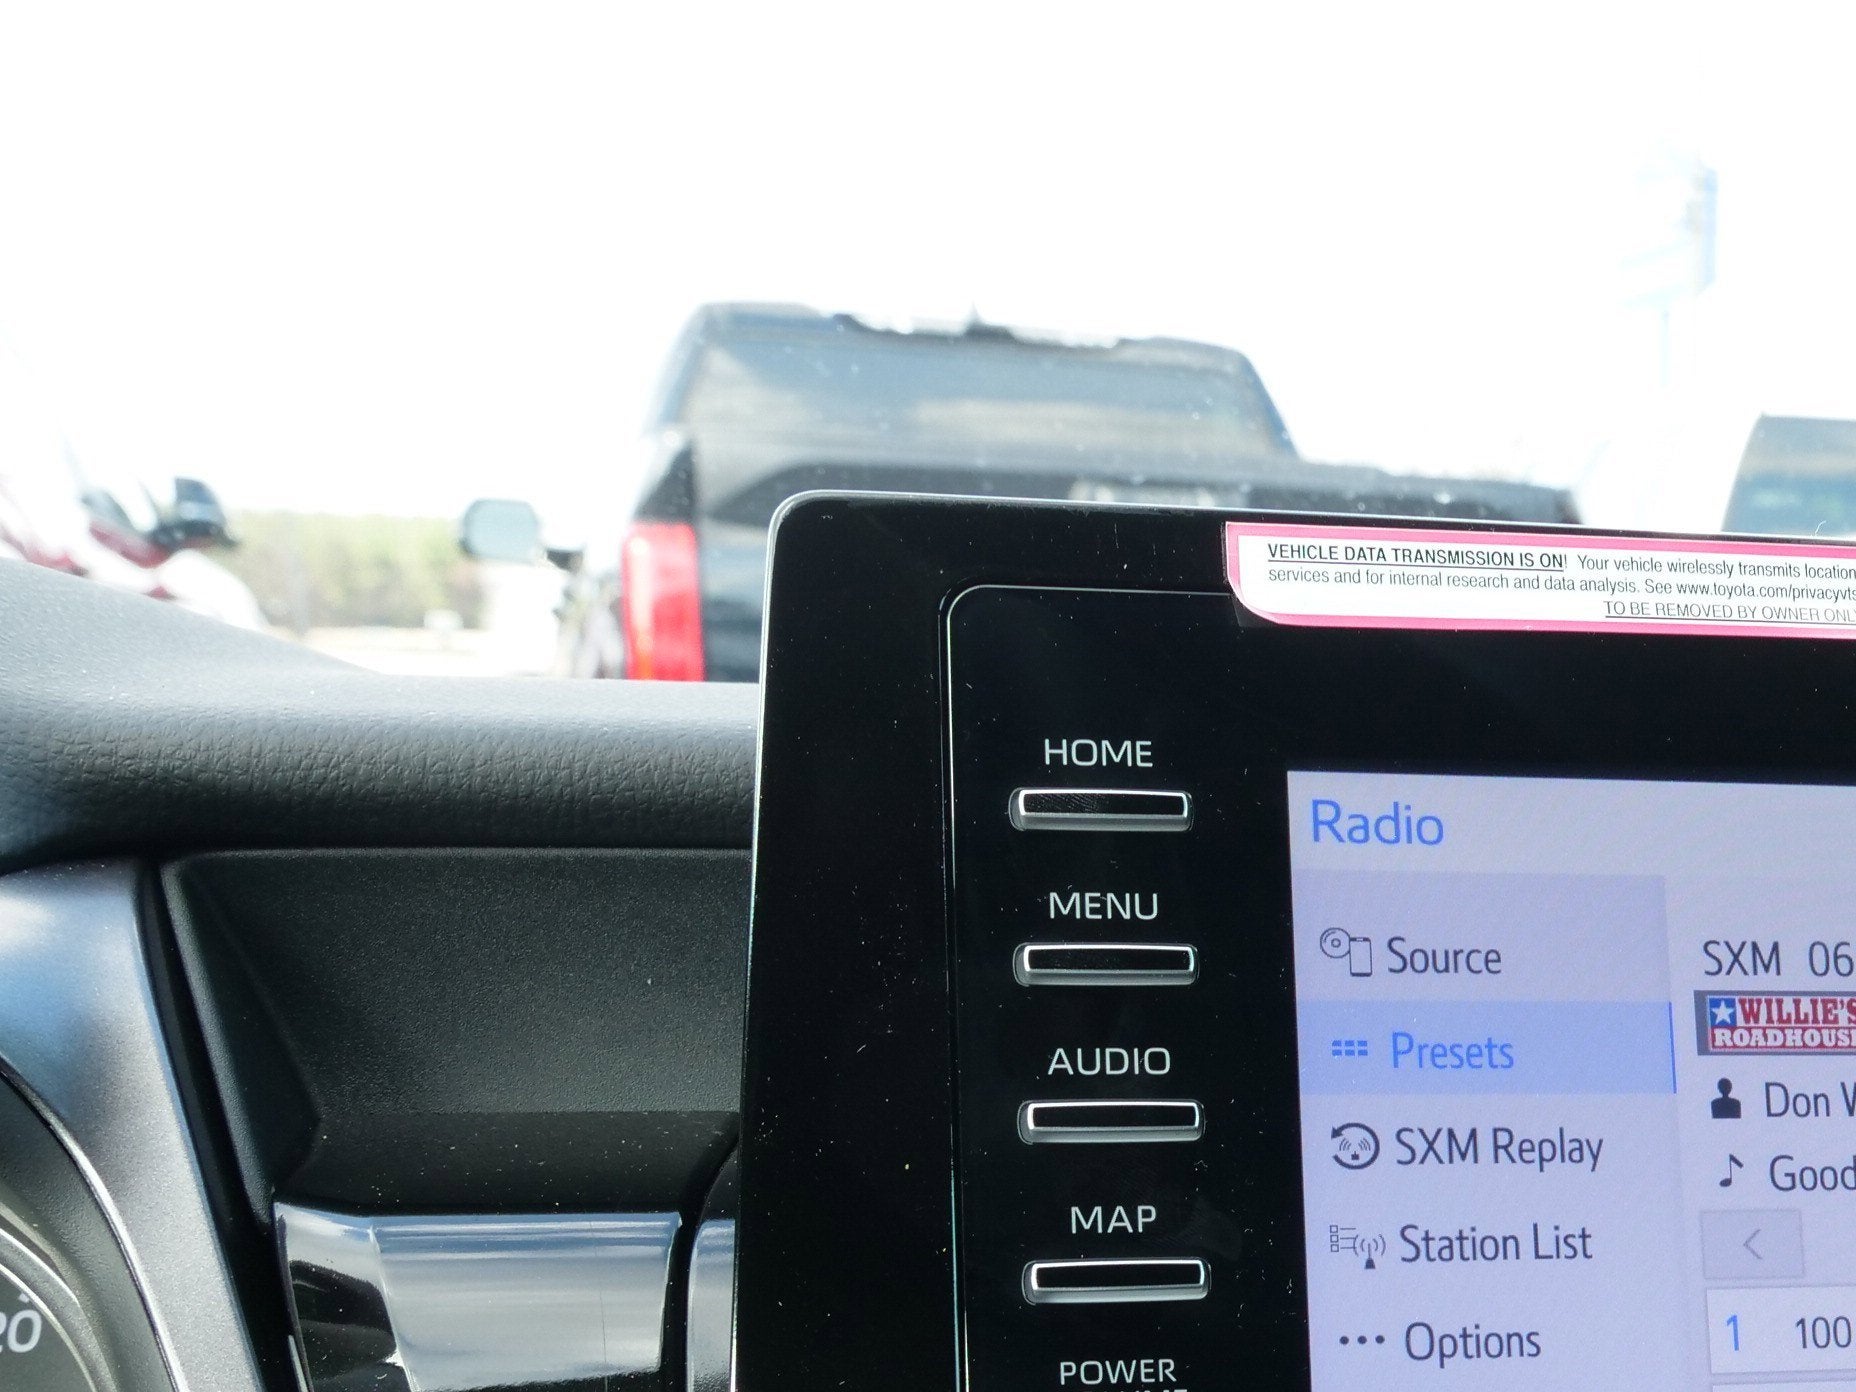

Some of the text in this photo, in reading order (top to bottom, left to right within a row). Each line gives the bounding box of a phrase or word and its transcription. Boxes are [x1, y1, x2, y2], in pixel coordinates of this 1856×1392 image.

[1268, 544, 1339, 560] VEHICLE
[1344, 546, 1387, 562] DATA
[1391, 548, 1515, 567] TRANSMISSION
[1519, 552, 1535, 567] IS
[1577, 555, 1609, 571] Your
[1614, 557, 1663, 572] vehicle
[1667, 559, 1734, 578] wirelessly
[1738, 562, 1801, 578] transmits
[1268, 567, 1330, 583] services
[1334, 569, 1361, 584] and
[1366, 569, 1384, 584] for
[1389, 570, 1442, 587] internal
[1447, 572, 1509, 588] research
[1513, 574, 1540, 590] and
[1544, 576, 1575, 591] data
[1579, 577, 1640, 595] analysis.
[1645, 579, 1672, 594] See
[1603, 600, 1626, 616] TO
[1630, 601, 1650, 616] BE
[1655, 602, 1733, 619] REMOVED
[1738, 604, 1759, 619] BY
[1762, 606, 1819, 622] OWNER
[1044, 738, 1154, 768] HOME
[1311, 799, 1445, 846] Radio
[1048, 892, 1159, 920] MENU
[1386, 936, 1502, 975] Source
[1702, 939, 1783, 978] SXM
[1047, 1047, 1171, 1076] AUDIO
[1391, 1031, 1515, 1069] Presets
[1764, 1081, 1831, 1118] Don
[1395, 1127, 1604, 1173] SXM Replay
[1070, 1205, 1158, 1235] MAP
[1400, 1221, 1593, 1263] Station List
[1405, 1321, 1542, 1369] Options
[1725, 1314, 1740, 1351] 1
[1059, 1358, 1178, 1386] POWER
